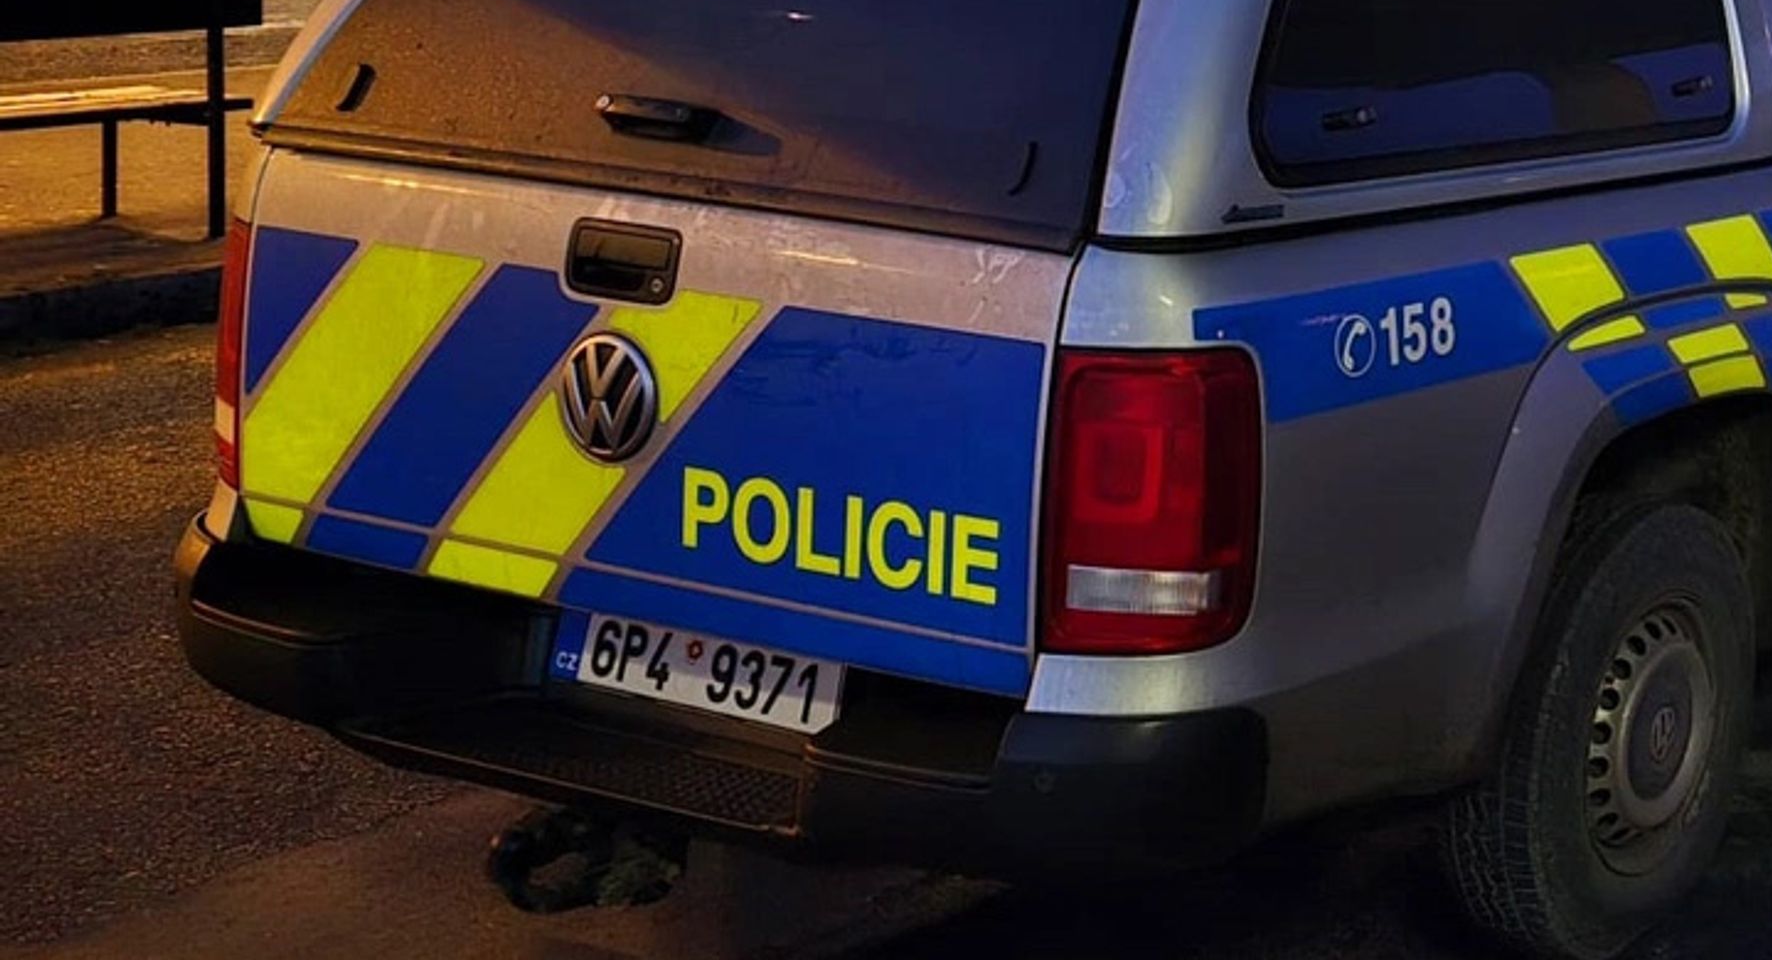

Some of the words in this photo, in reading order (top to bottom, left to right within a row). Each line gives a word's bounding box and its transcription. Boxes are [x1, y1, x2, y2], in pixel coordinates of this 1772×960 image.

[1380, 296, 1455, 367] 158
[681, 465, 999, 606] POLICIE
[556, 651, 577, 671] CZ
[590, 619, 673, 692] 6P4
[706, 643, 819, 726] 9371
